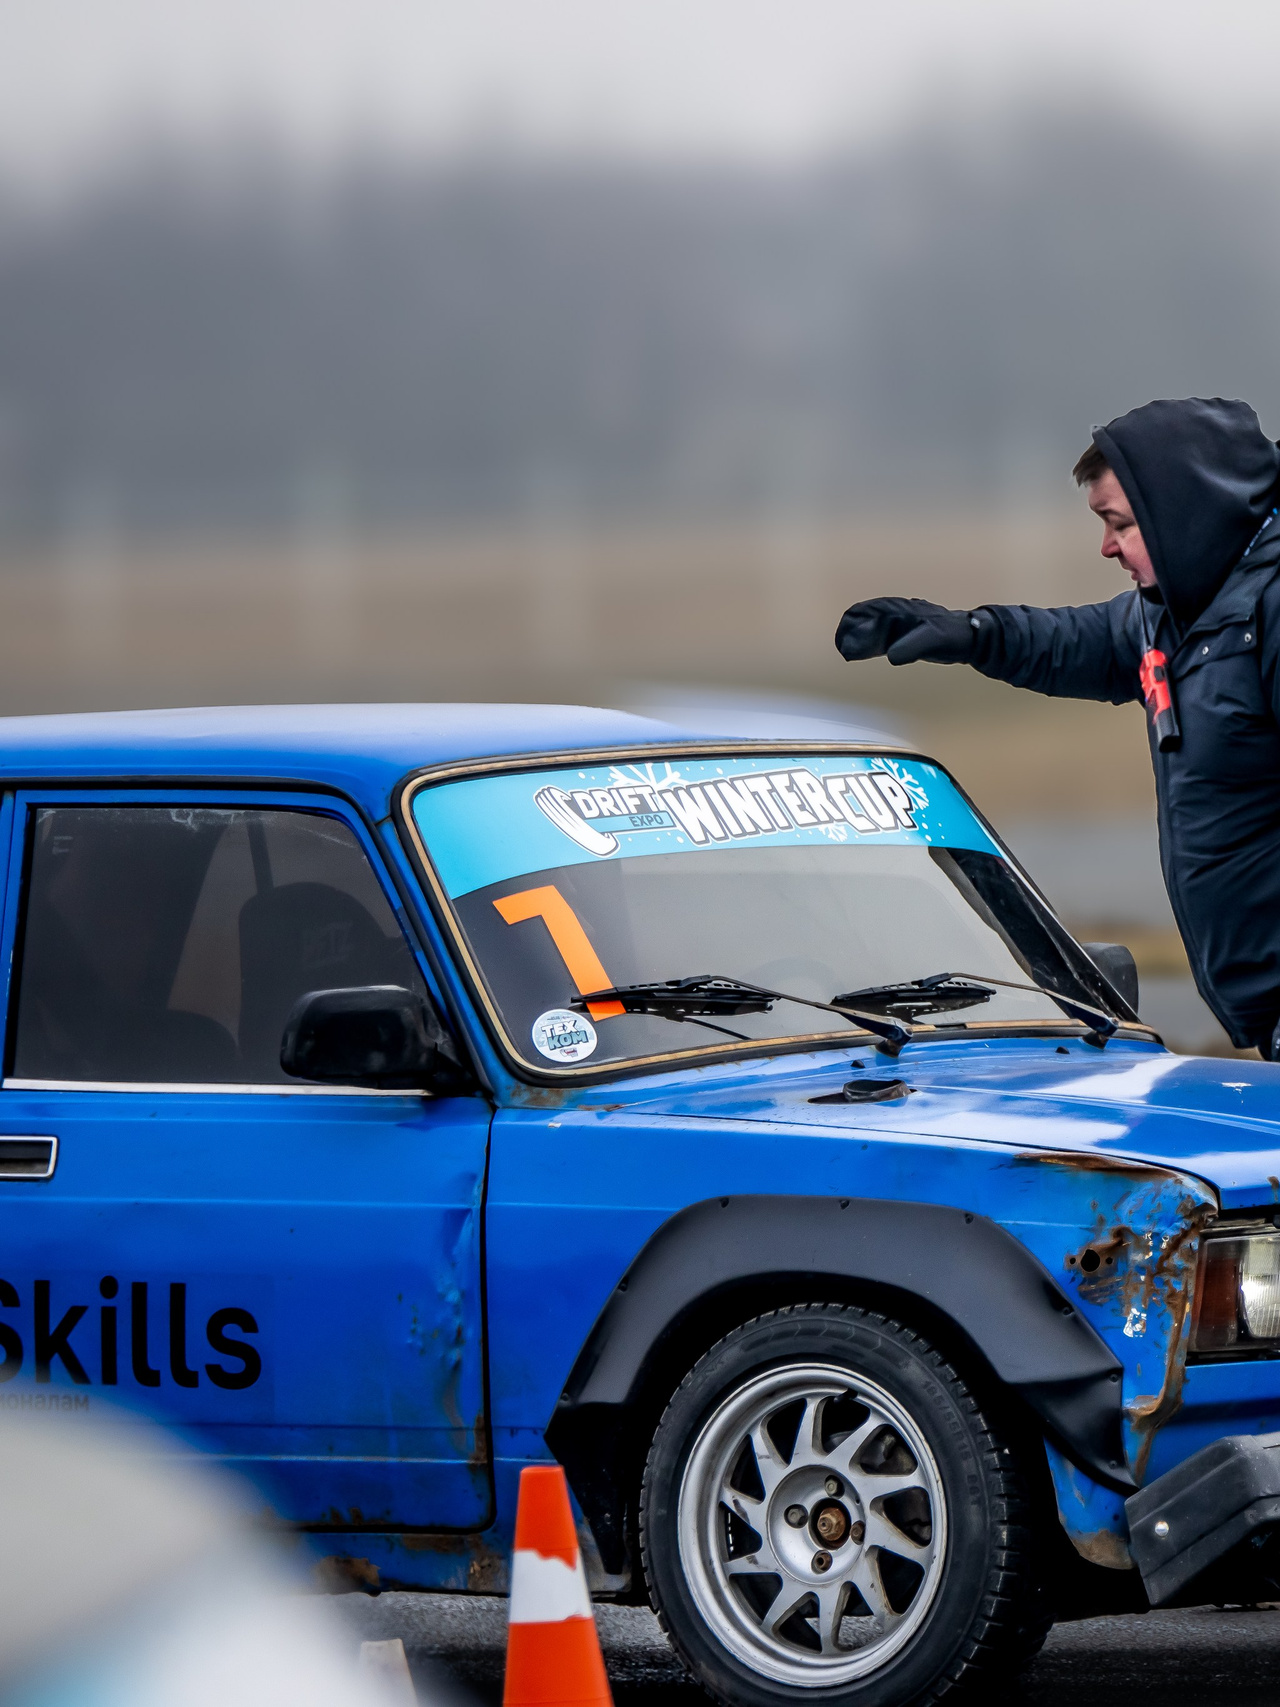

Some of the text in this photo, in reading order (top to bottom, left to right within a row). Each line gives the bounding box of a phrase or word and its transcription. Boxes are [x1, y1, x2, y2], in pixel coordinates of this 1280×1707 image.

[571, 785, 661, 819] DRIFT
[658, 769, 918, 844] WINTER CUP
[628, 814, 664, 828] EXPO
[0, 1393, 90, 1412] оналам
